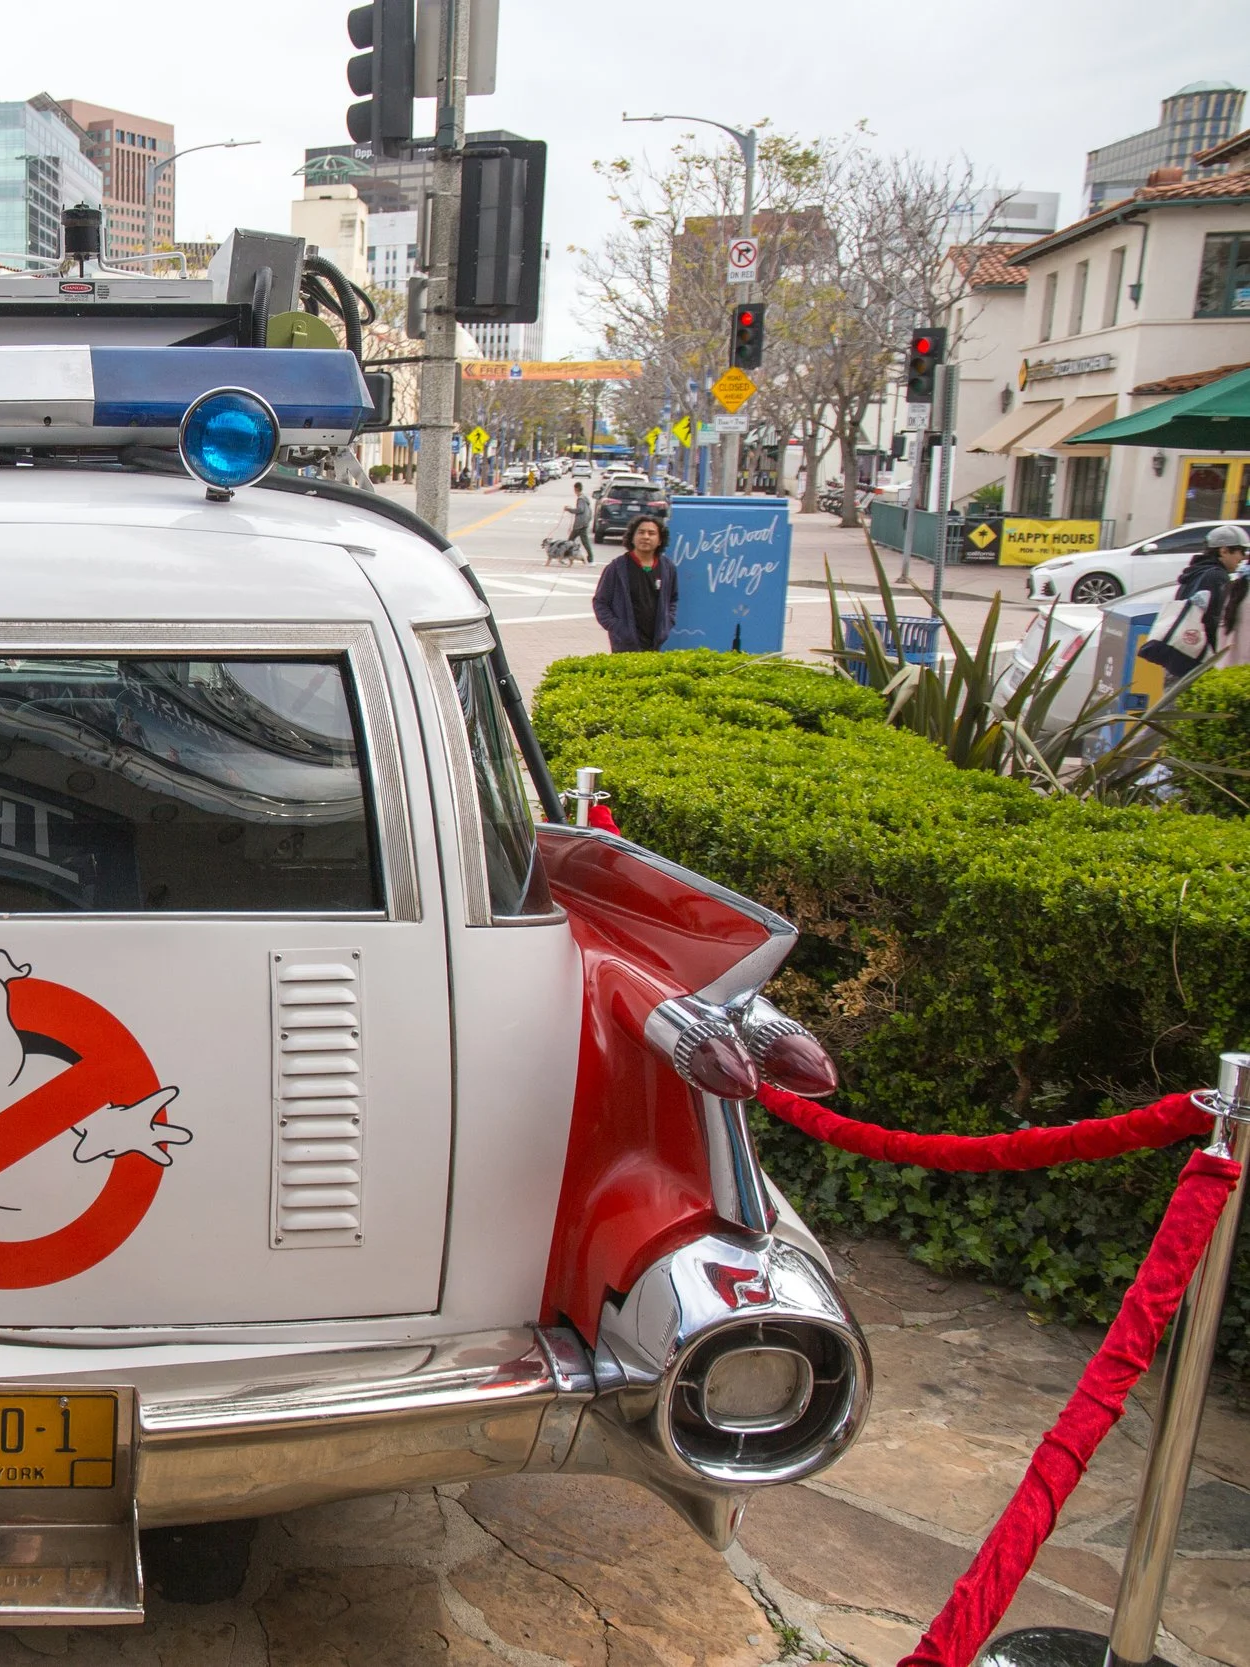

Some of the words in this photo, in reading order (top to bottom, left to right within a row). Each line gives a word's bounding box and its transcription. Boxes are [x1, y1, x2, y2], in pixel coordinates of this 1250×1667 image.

[730, 271, 740, 279] ON
[741, 270, 755, 278] RED
[718, 382, 750, 392] CLOSED
[672, 514, 779, 567] Westwood
[1007, 532, 1049, 544] HAPPY
[1052, 533, 1095, 545] HOURS
[707, 555, 780, 596] Village
